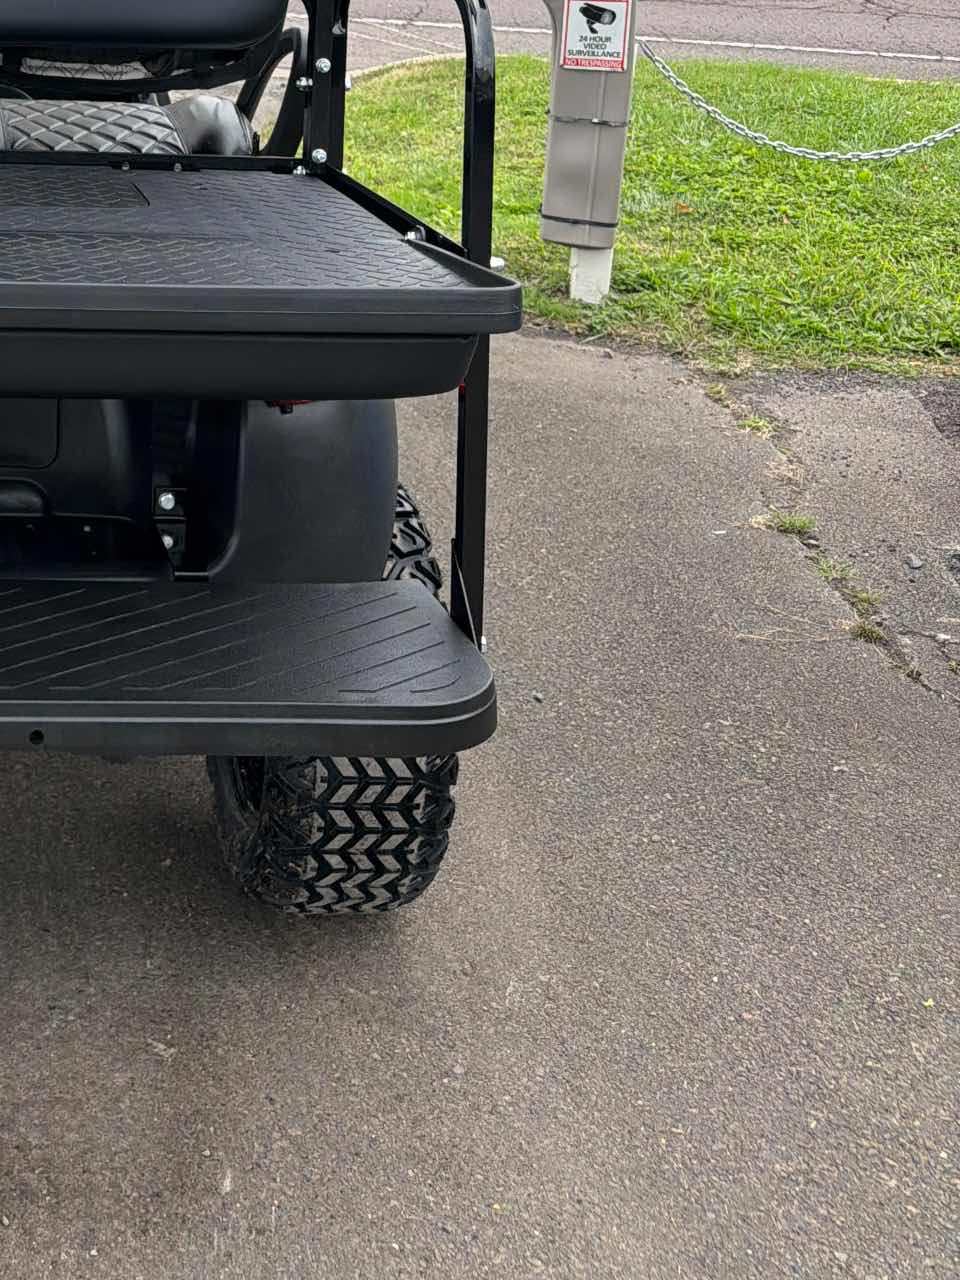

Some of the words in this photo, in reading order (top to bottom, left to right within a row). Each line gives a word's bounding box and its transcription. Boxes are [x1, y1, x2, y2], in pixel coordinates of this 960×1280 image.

[584, 42, 607, 50] VIDEO
[568, 49, 621, 58] SURVEILLANCE
[565, 58, 577, 66] NO
[578, 59, 622, 68] TRESPASSING
